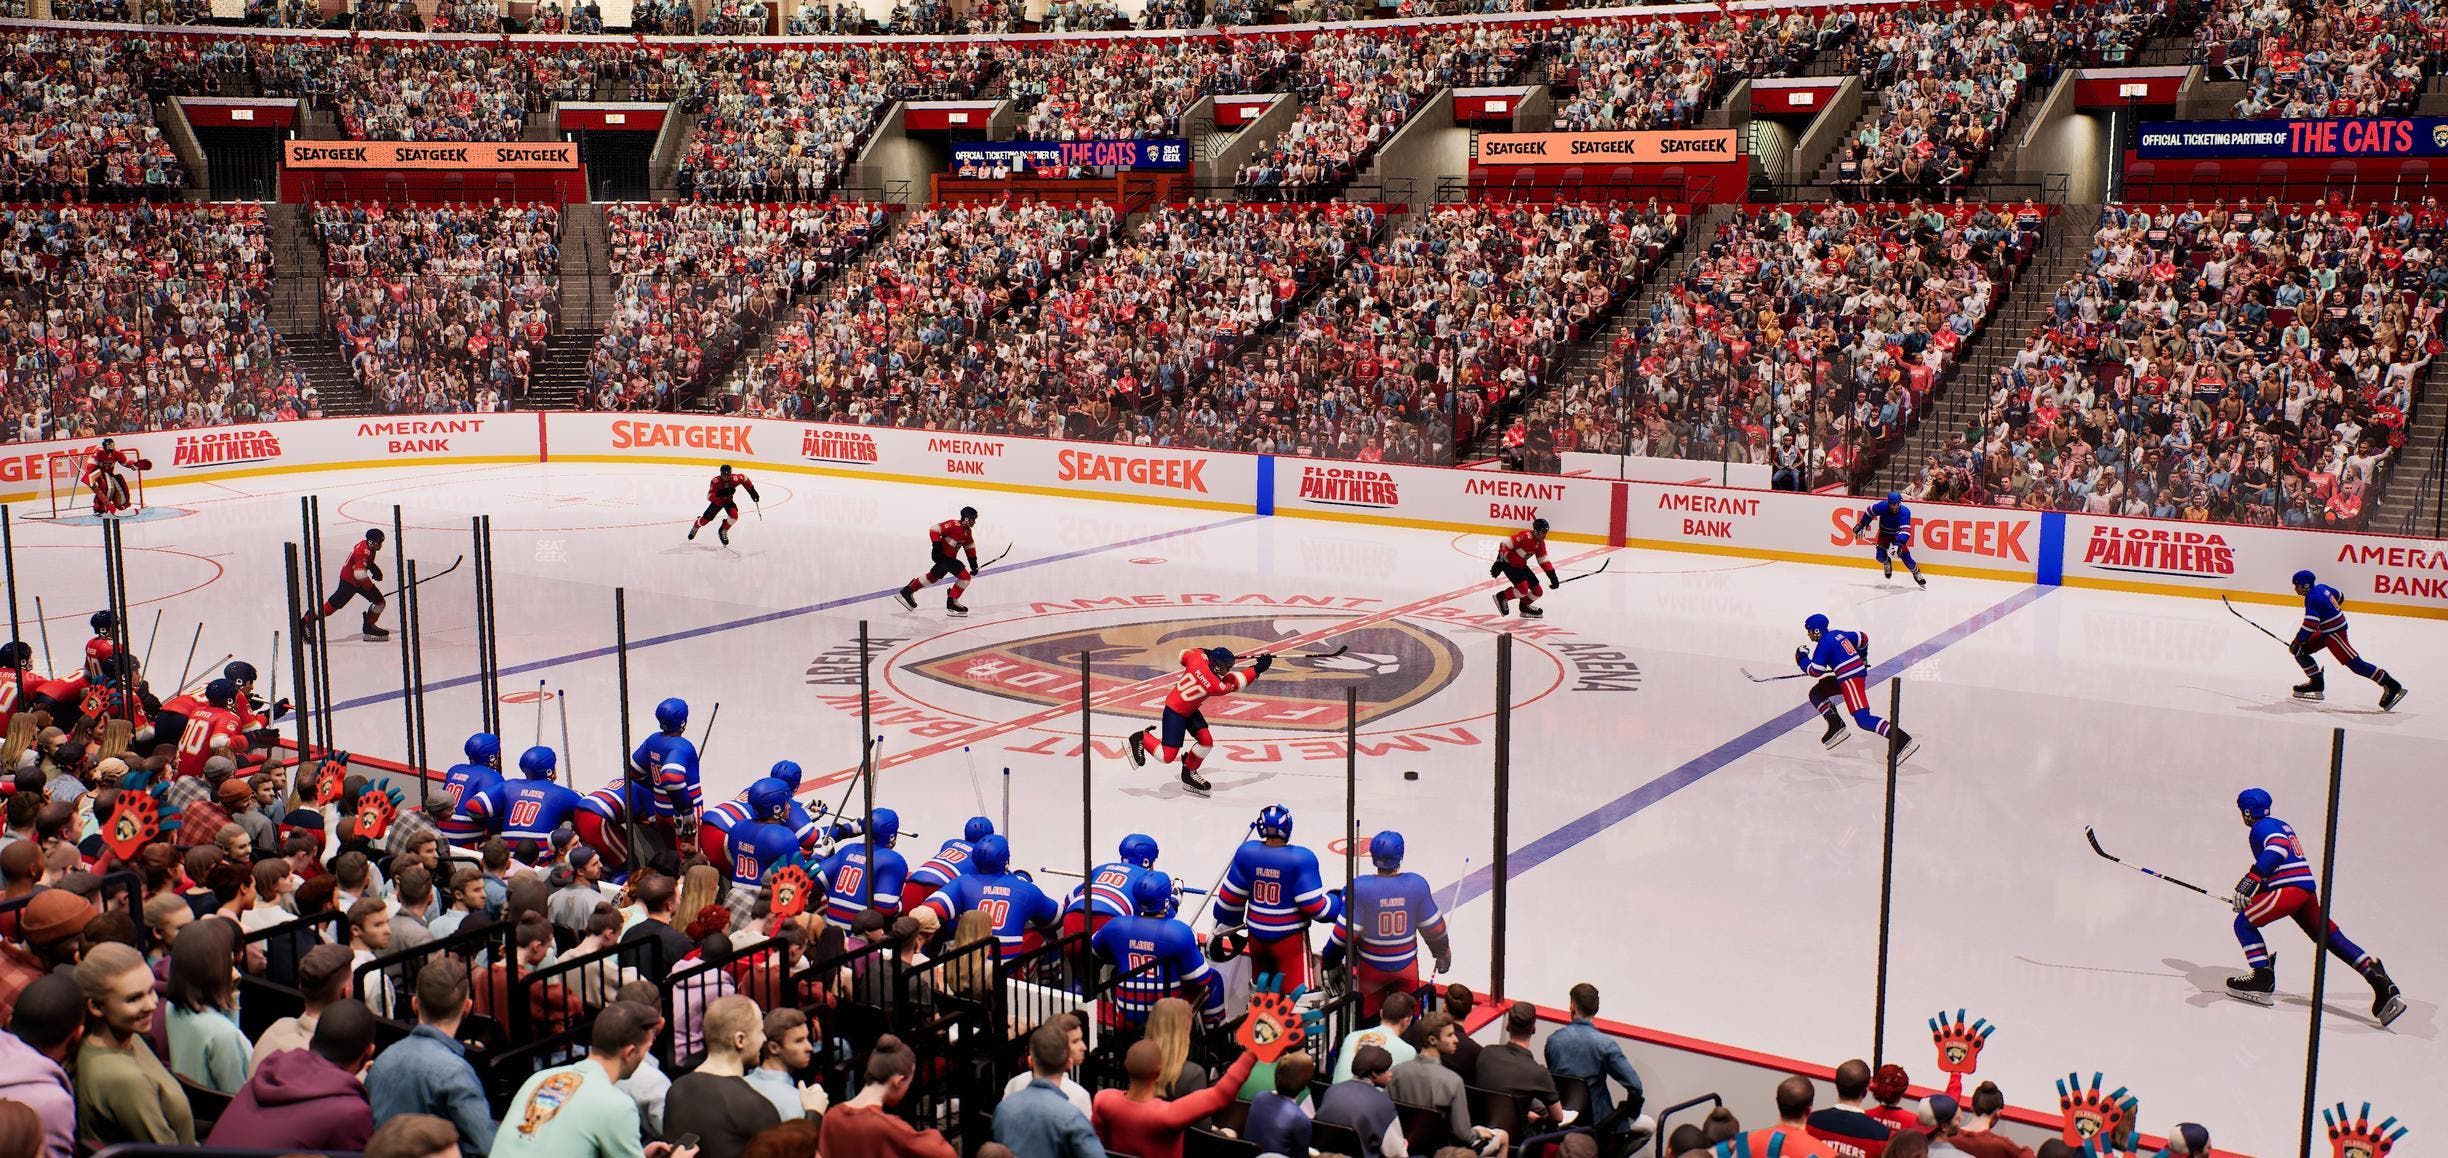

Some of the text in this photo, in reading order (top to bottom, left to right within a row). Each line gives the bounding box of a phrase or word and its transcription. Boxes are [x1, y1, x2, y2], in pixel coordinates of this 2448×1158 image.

[1571, 140, 1635, 154] SEATGEEK
[1660, 138, 1727, 153] SEATGEEK
[2143, 120, 2413, 153] OFFICIAL TICKETING PARTNER OF THE CATS
[293, 147, 367, 162] SEATGEEK
[396, 148, 468, 162] SEATGEEK
[497, 148, 569, 162] SEATGEEK
[955, 151, 984, 160] OFFICIAL
[1059, 143, 1092, 165] THE
[1095, 142, 1136, 165] CATS
[1163, 145, 1181, 154] SEAT
[1486, 141, 1547, 155] SEATGEEK
[176, 430, 273, 445] FLORIDA
[357, 420, 485, 437] AMERANT
[611, 420, 754, 456] SEATGEEK
[804, 429, 873, 442] FLORIDA
[172, 437, 282, 466] PANTHERS
[388, 438, 449, 454] BANK
[801, 438, 878, 462] PANTHERS
[928, 438, 1005, 457] AMERANT
[946, 459, 985, 476] BANK
[1058, 448, 1208, 494] SEATGEEK
[1303, 466, 1393, 482] FLORIDA
[1299, 477, 1399, 506] PANTHERS
[1465, 478, 1566, 501] AMERANT
[1489, 503, 1538, 522] BANK
[1658, 493, 1761, 517] AMERANT
[1682, 518, 1733, 539] BANK
[2093, 525, 2227, 547] FLORIDA
[2083, 541, 2236, 575] PANTHERS
[2374, 574, 2448, 600] BANK
[1029, 592, 1383, 614] AMERANT
[1194, 668, 1212, 688] PLAYER
[1547, 643, 1642, 692] ARENA
[1176, 671, 1208, 703] 00
[178, 718, 210, 756] 00
[508, 800, 541, 827] 00
[936, 847, 968, 864] 00
[736, 853, 759, 880] 00
[1255, 867, 1281, 878] PLAYER
[834, 865, 864, 897] 00
[1095, 871, 1128, 889] 00
[1254, 880, 1281, 906] 00
[1379, 897, 1405, 907] PLAYER
[1378, 910, 1407, 937] 00
[1128, 939, 1155, 952] PLAYER
